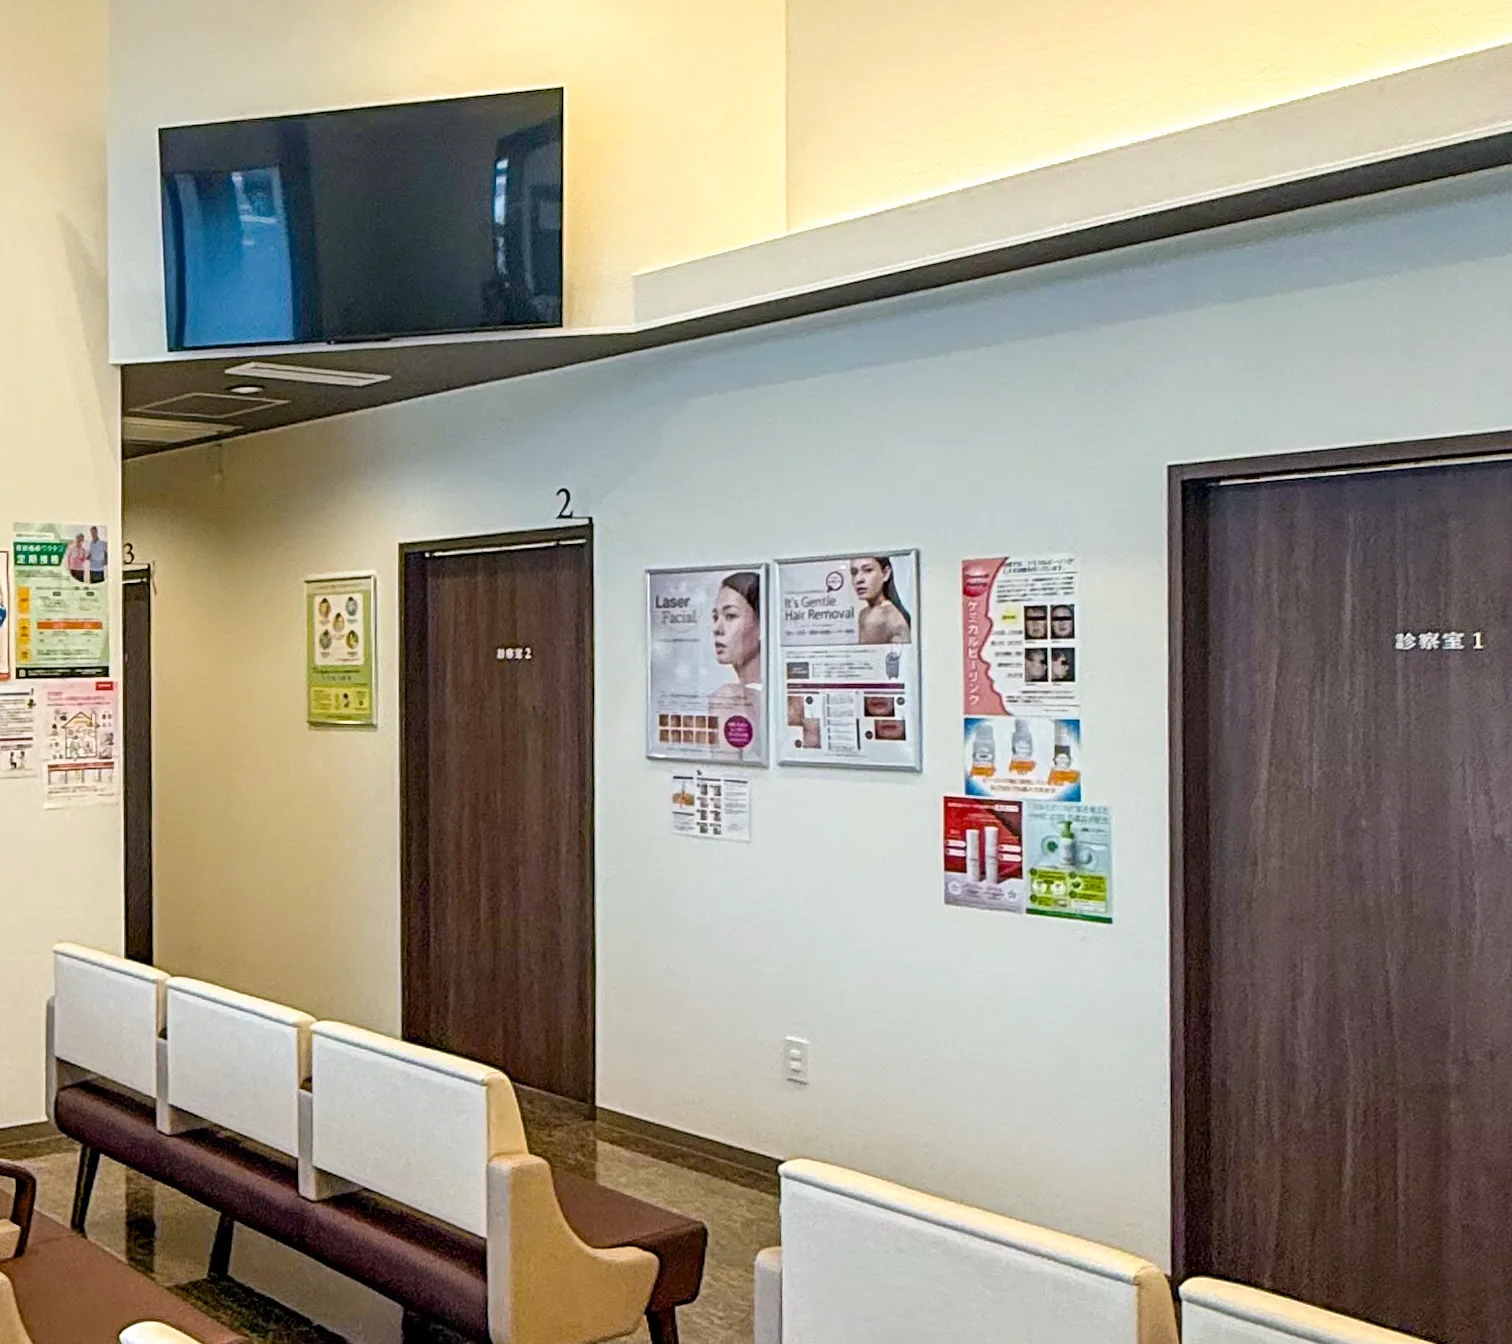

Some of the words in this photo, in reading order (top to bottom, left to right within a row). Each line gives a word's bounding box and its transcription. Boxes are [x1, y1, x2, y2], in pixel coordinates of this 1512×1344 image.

[555, 488, 573, 519] 2
[123, 542, 135, 565] 3
[655, 595, 691, 609] Laser
[801, 596, 837, 608] Gentle
[661, 609, 698, 626] Facial
[785, 609, 805, 621] Hair
[808, 605, 855, 620] Removal
[1394, 631, 1465, 651] 診察室
[1473, 631, 1485, 650] 1
[524, 647, 533, 660] 2
